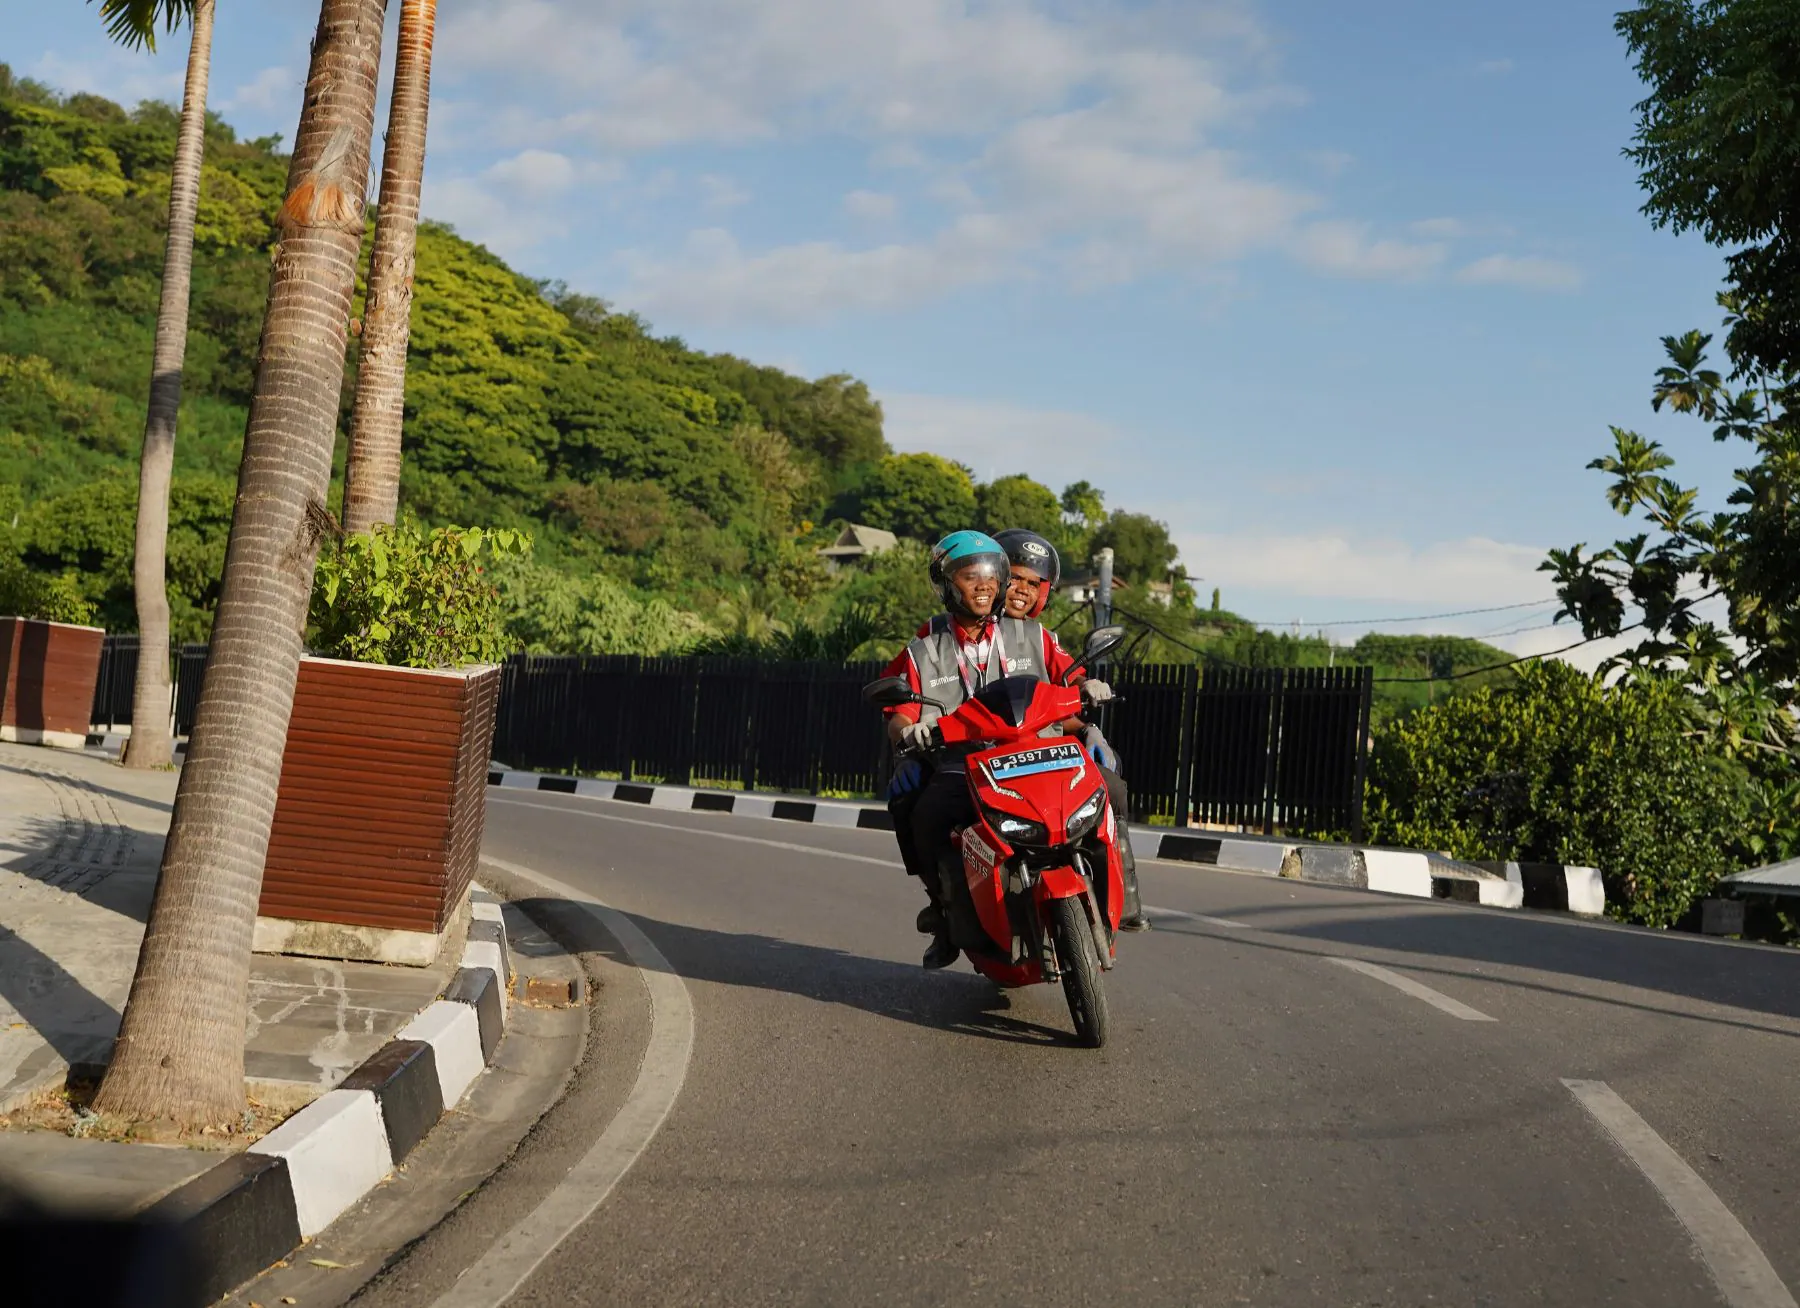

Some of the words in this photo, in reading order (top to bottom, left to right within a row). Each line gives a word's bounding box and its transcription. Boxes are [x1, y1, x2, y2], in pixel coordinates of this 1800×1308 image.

[992, 758, 1001, 768] B
[1008, 751, 1042, 764] 3597
[1049, 745, 1079, 758] PWA
